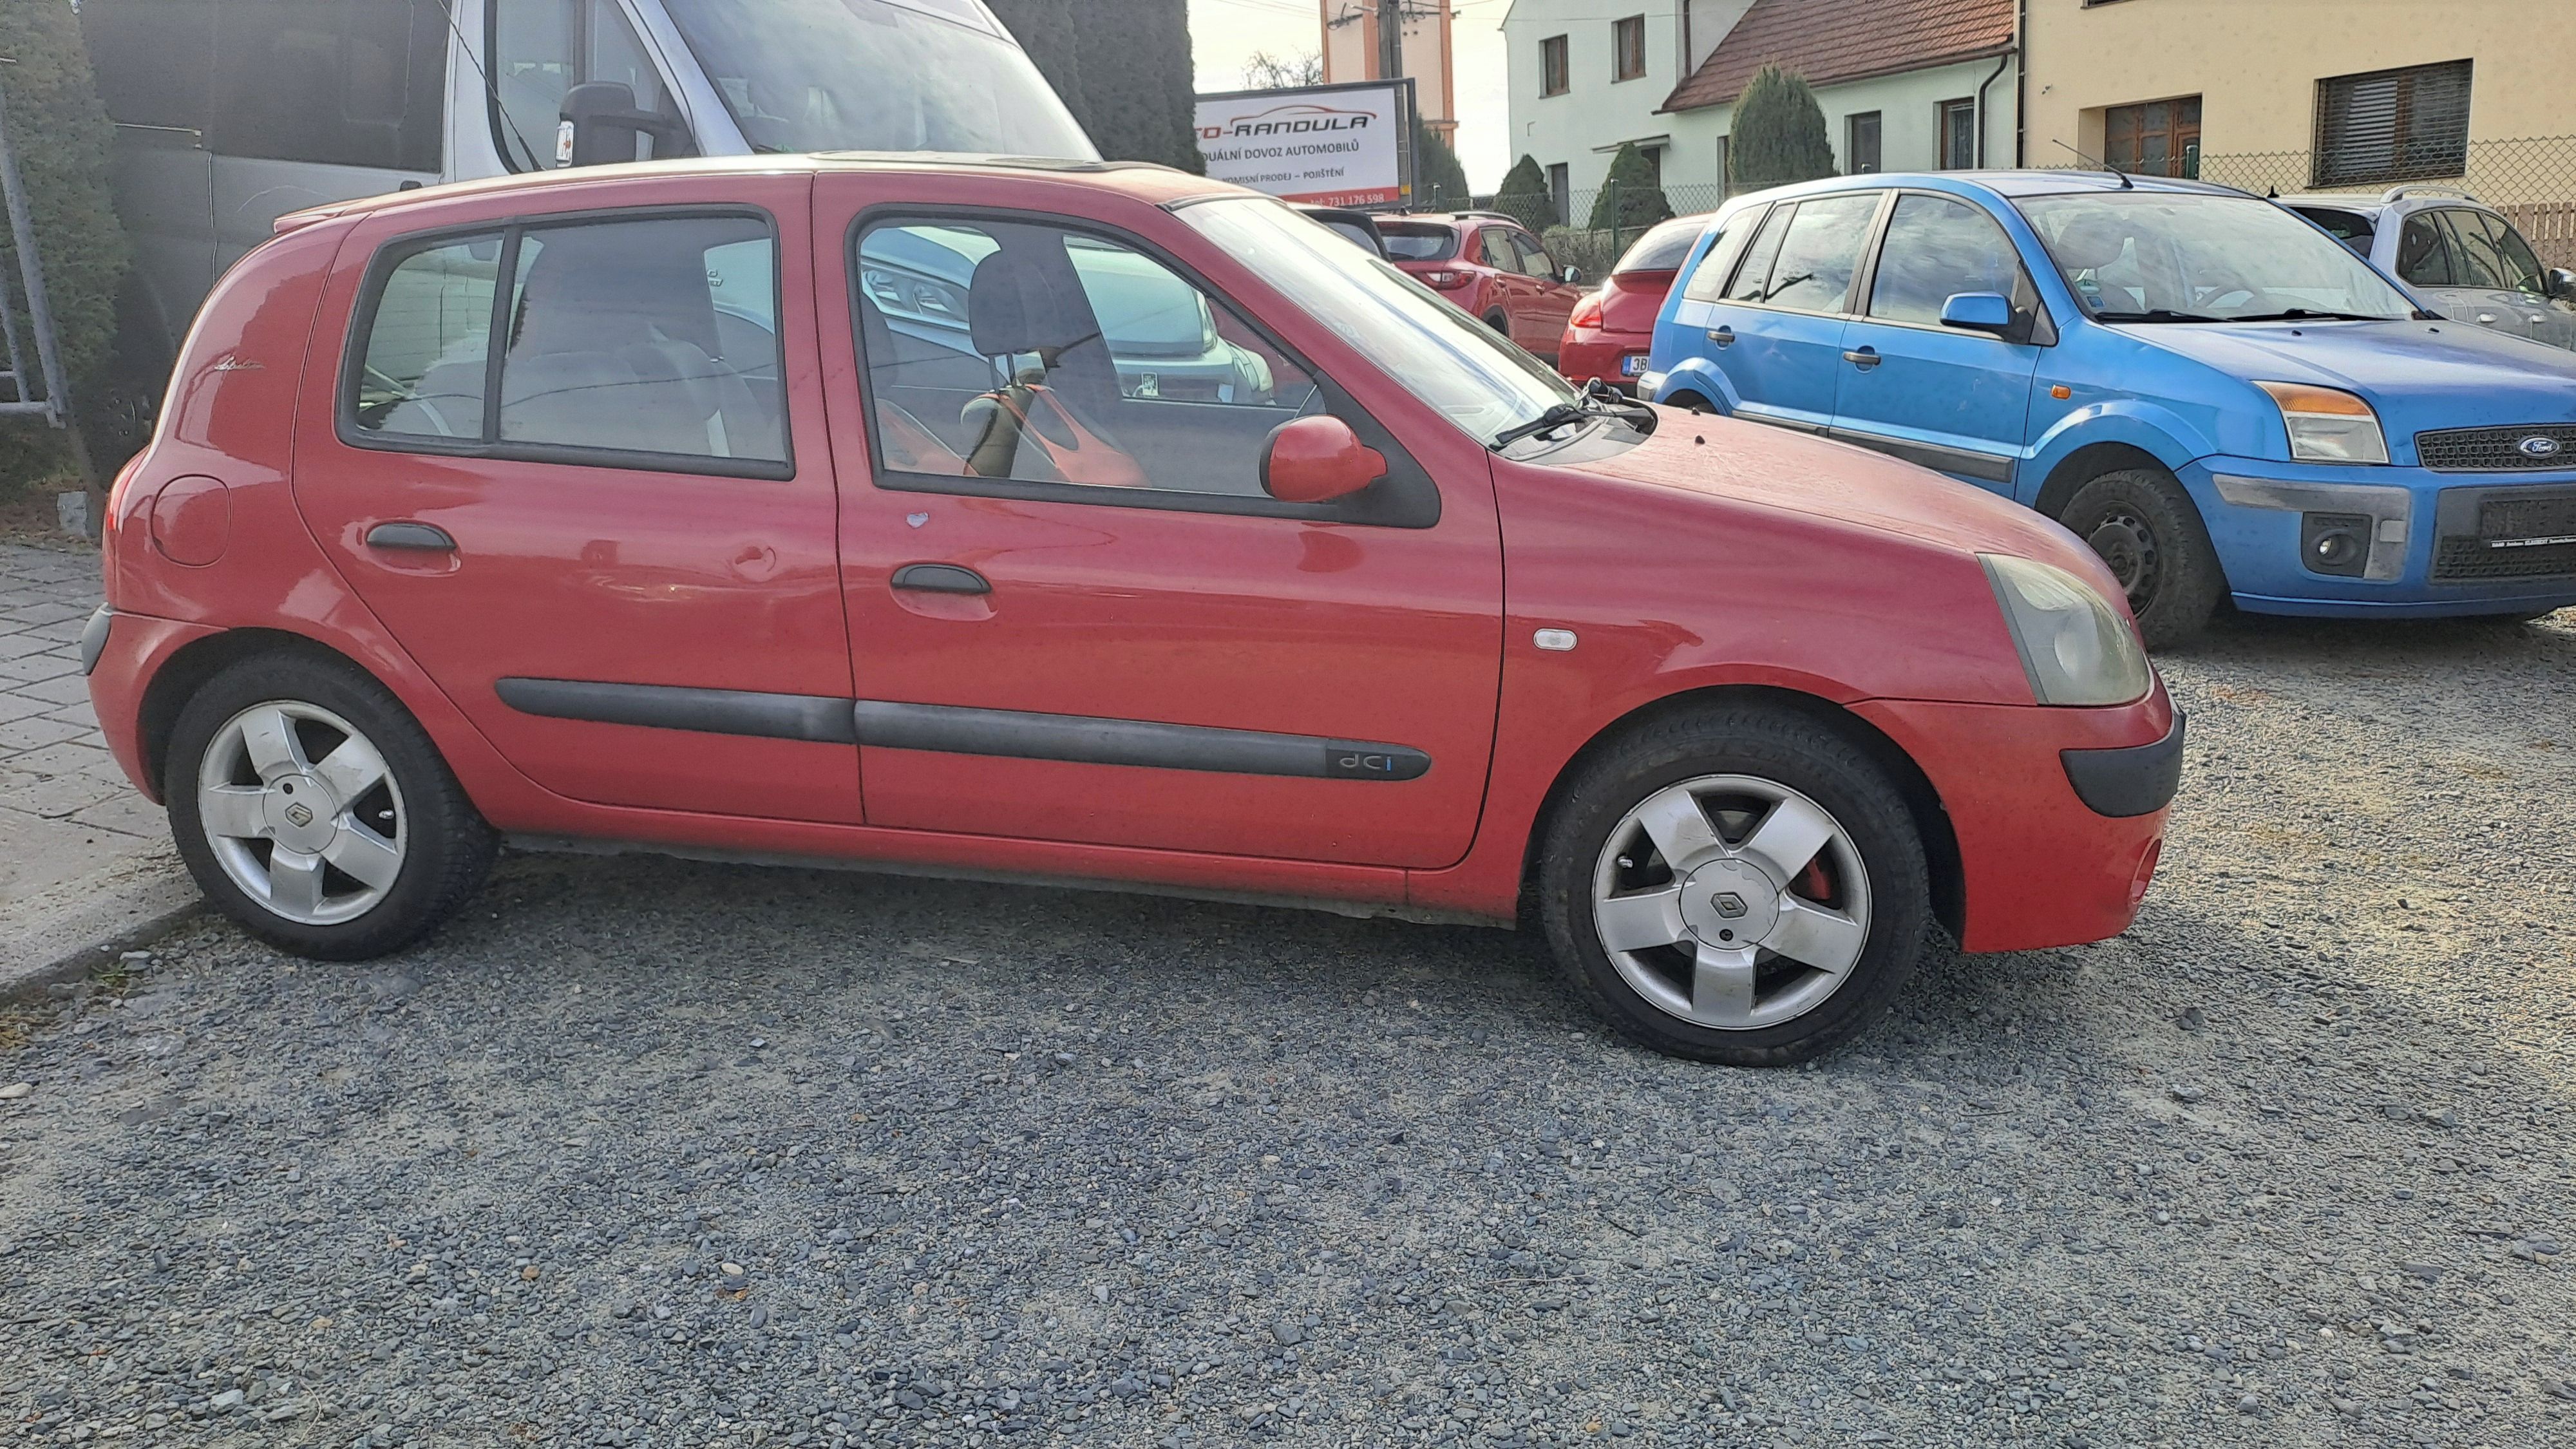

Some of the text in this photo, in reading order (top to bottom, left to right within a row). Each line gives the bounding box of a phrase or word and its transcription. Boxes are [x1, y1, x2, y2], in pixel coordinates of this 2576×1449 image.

[1195, 117, 1368, 139] O-RANDULA
[1244, 147, 1283, 160] DOVOZ
[1285, 138, 1359, 157] AUTOMOBILŮ
[1260, 172, 1292, 182] PRODEJ
[1303, 166, 1345, 180] POJIŠTĚNÍ
[1328, 196, 1346, 207] 731
[1349, 194, 1365, 205] 176
[1367, 193, 1385, 204] 598
[2532, 441, 2553, 452] Ford
